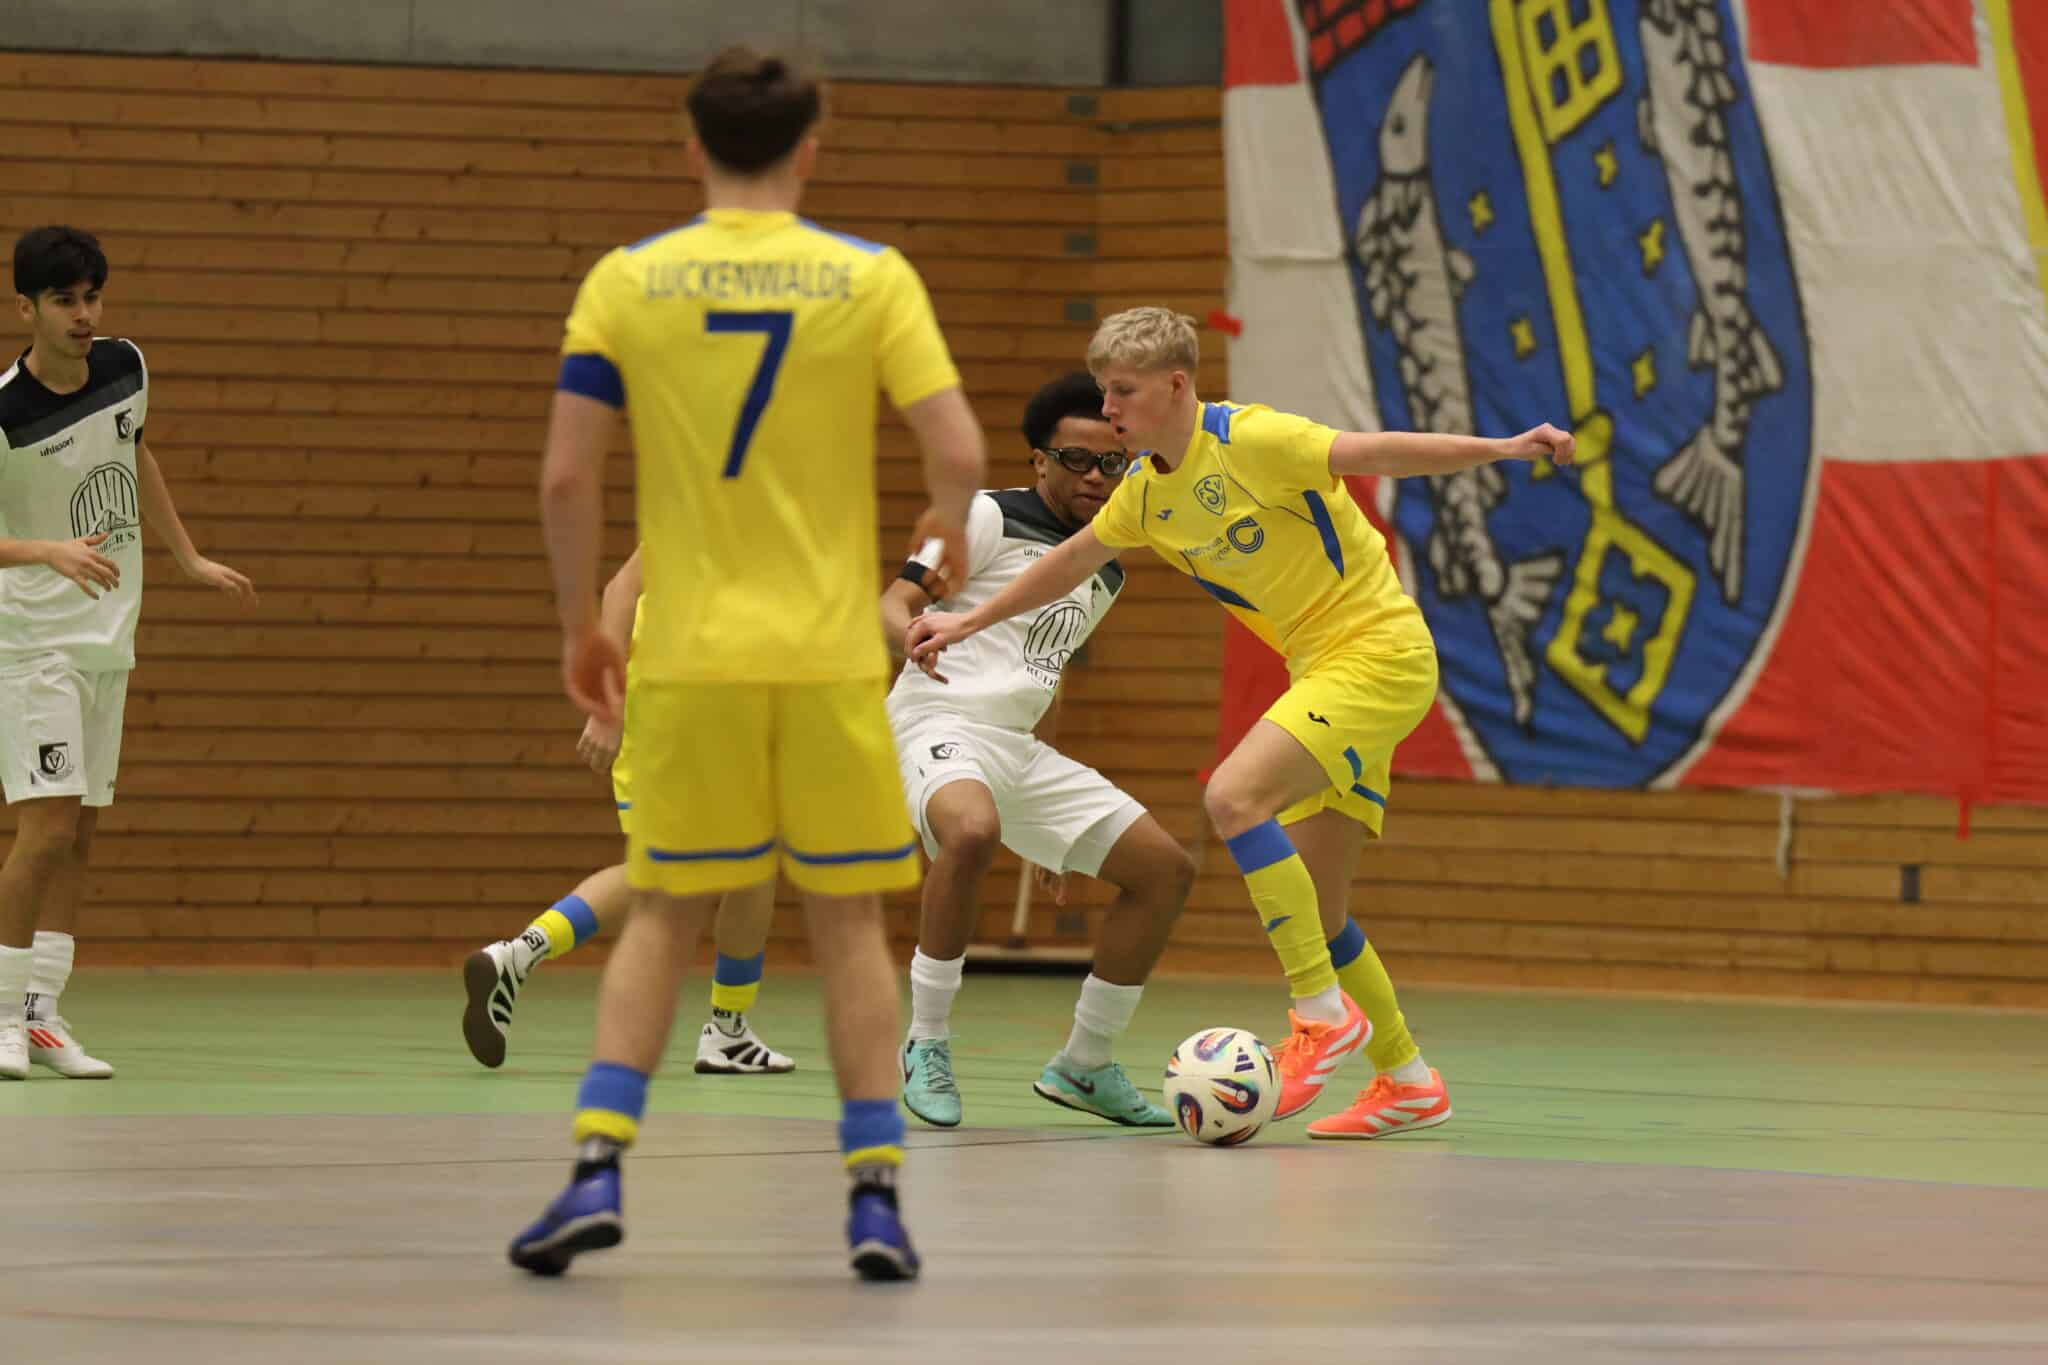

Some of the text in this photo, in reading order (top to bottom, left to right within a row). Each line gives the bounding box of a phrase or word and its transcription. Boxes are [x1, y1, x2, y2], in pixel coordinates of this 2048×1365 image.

[646, 259, 853, 301] LUCKENWALDE
[704, 311, 794, 478] 7
[1026, 665, 1058, 689] RUDI
